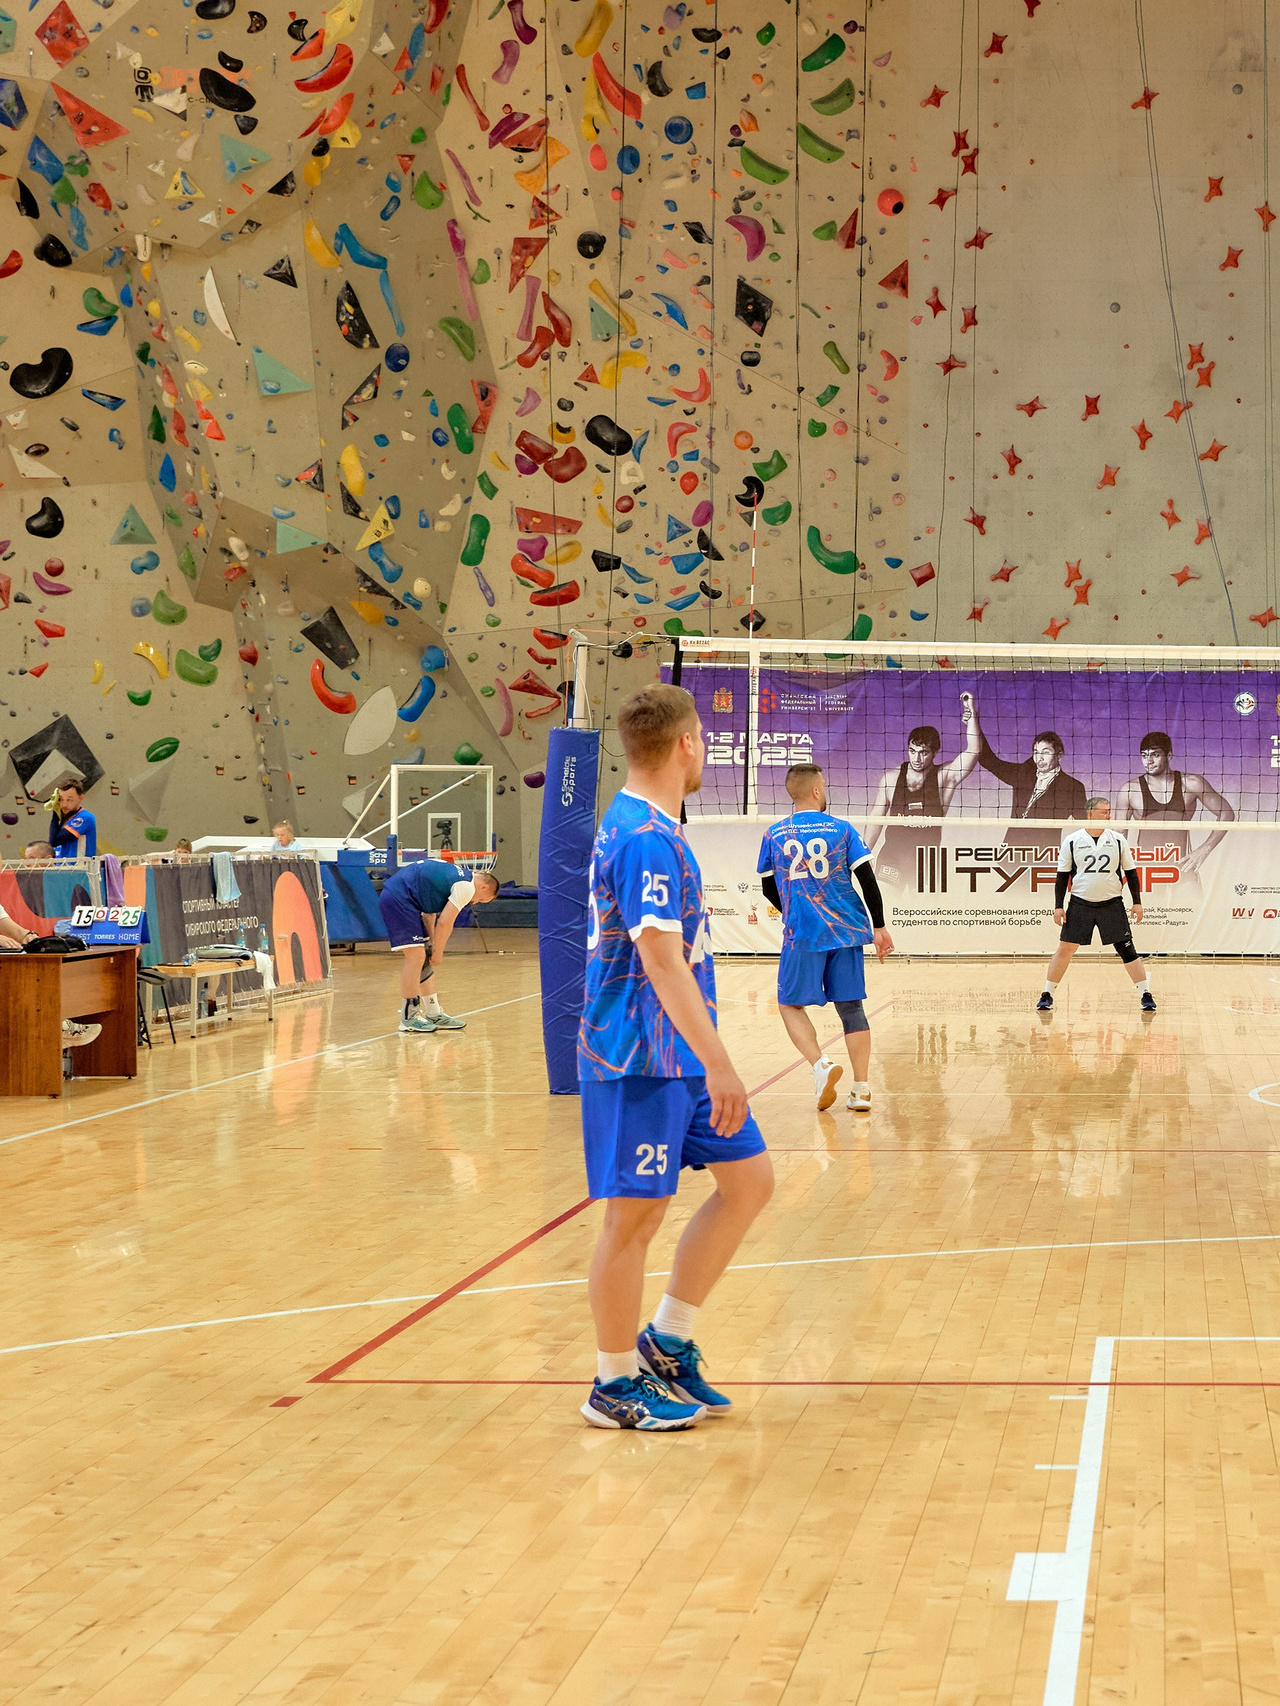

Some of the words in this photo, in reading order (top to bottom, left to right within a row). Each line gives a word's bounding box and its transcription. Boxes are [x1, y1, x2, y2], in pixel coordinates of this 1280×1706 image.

[706, 732, 734, 744] 1-2
[706, 745, 813, 765] 2025
[783, 837, 829, 880] 28
[1083, 854, 1111, 873] 22
[641, 870, 670, 907] 25
[76, 909, 93, 924] 15
[110, 910, 119, 919] 2
[122, 910, 140, 925] 25
[892, 907, 963, 918] Всероссийские
[964, 909, 1029, 918] соревнования
[892, 918, 938, 928] студентов
[952, 917, 1007, 928] спортивной
[1008, 918, 1042, 926] борьбе
[635, 1143, 669, 1175] 25
